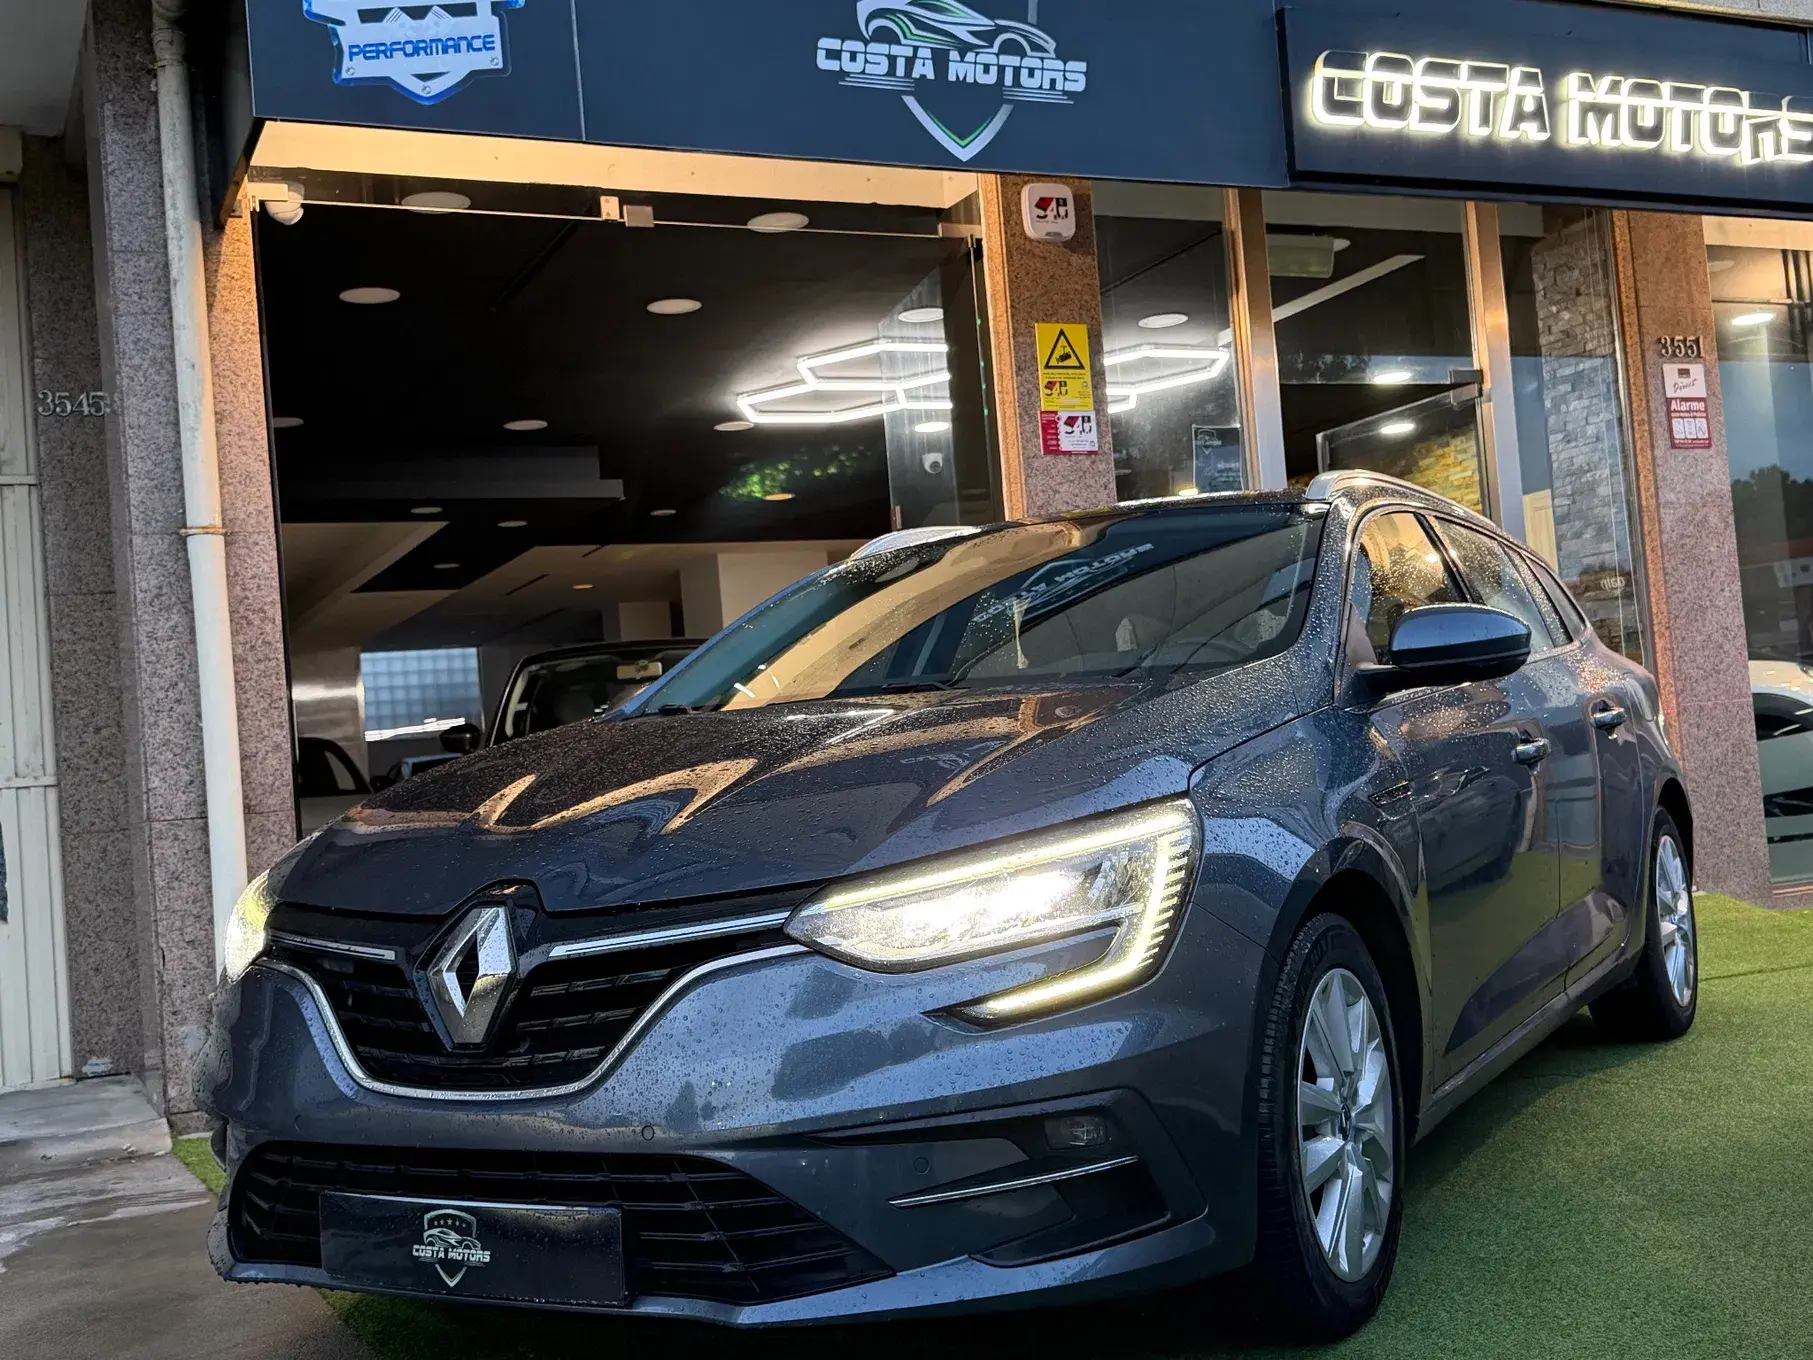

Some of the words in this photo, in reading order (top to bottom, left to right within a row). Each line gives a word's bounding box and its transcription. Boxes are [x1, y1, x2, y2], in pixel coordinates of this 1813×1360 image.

[348, 34, 496, 62] PERFORMANCE
[816, 37, 935, 80] COSTA
[948, 50, 1087, 92] MOTORS
[1311, 50, 1551, 140] COSTA
[1660, 335, 1705, 358] 3551
[37, 389, 105, 417] 3545
[1670, 399, 1706, 412] Alarme
[412, 1244, 445, 1259] COSTA
[447, 1248, 491, 1263] MOTORS
